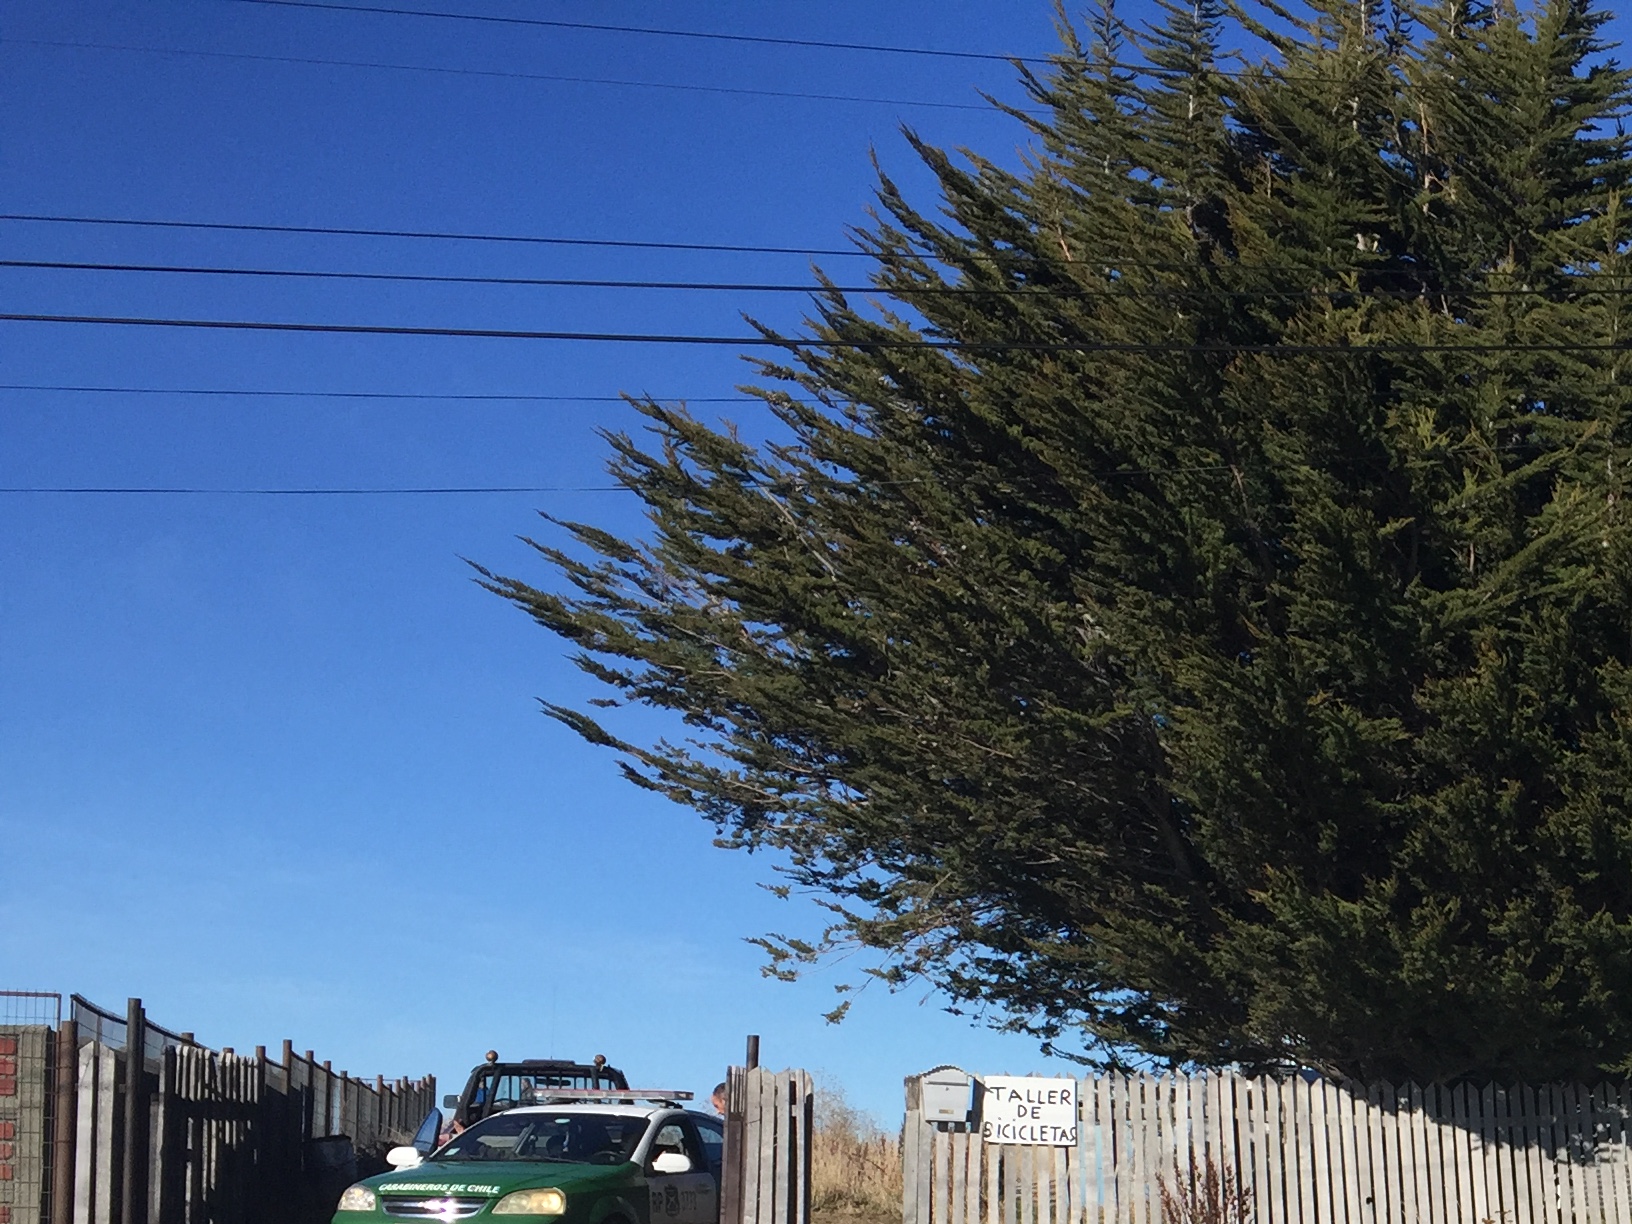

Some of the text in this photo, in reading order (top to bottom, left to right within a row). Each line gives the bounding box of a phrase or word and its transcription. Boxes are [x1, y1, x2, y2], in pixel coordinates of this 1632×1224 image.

[989, 1087, 1072, 1106] TALLER
[1017, 1104, 1042, 1120] DE
[449, 1183, 466, 1192] DE
[466, 1184, 501, 1194] CHILE
